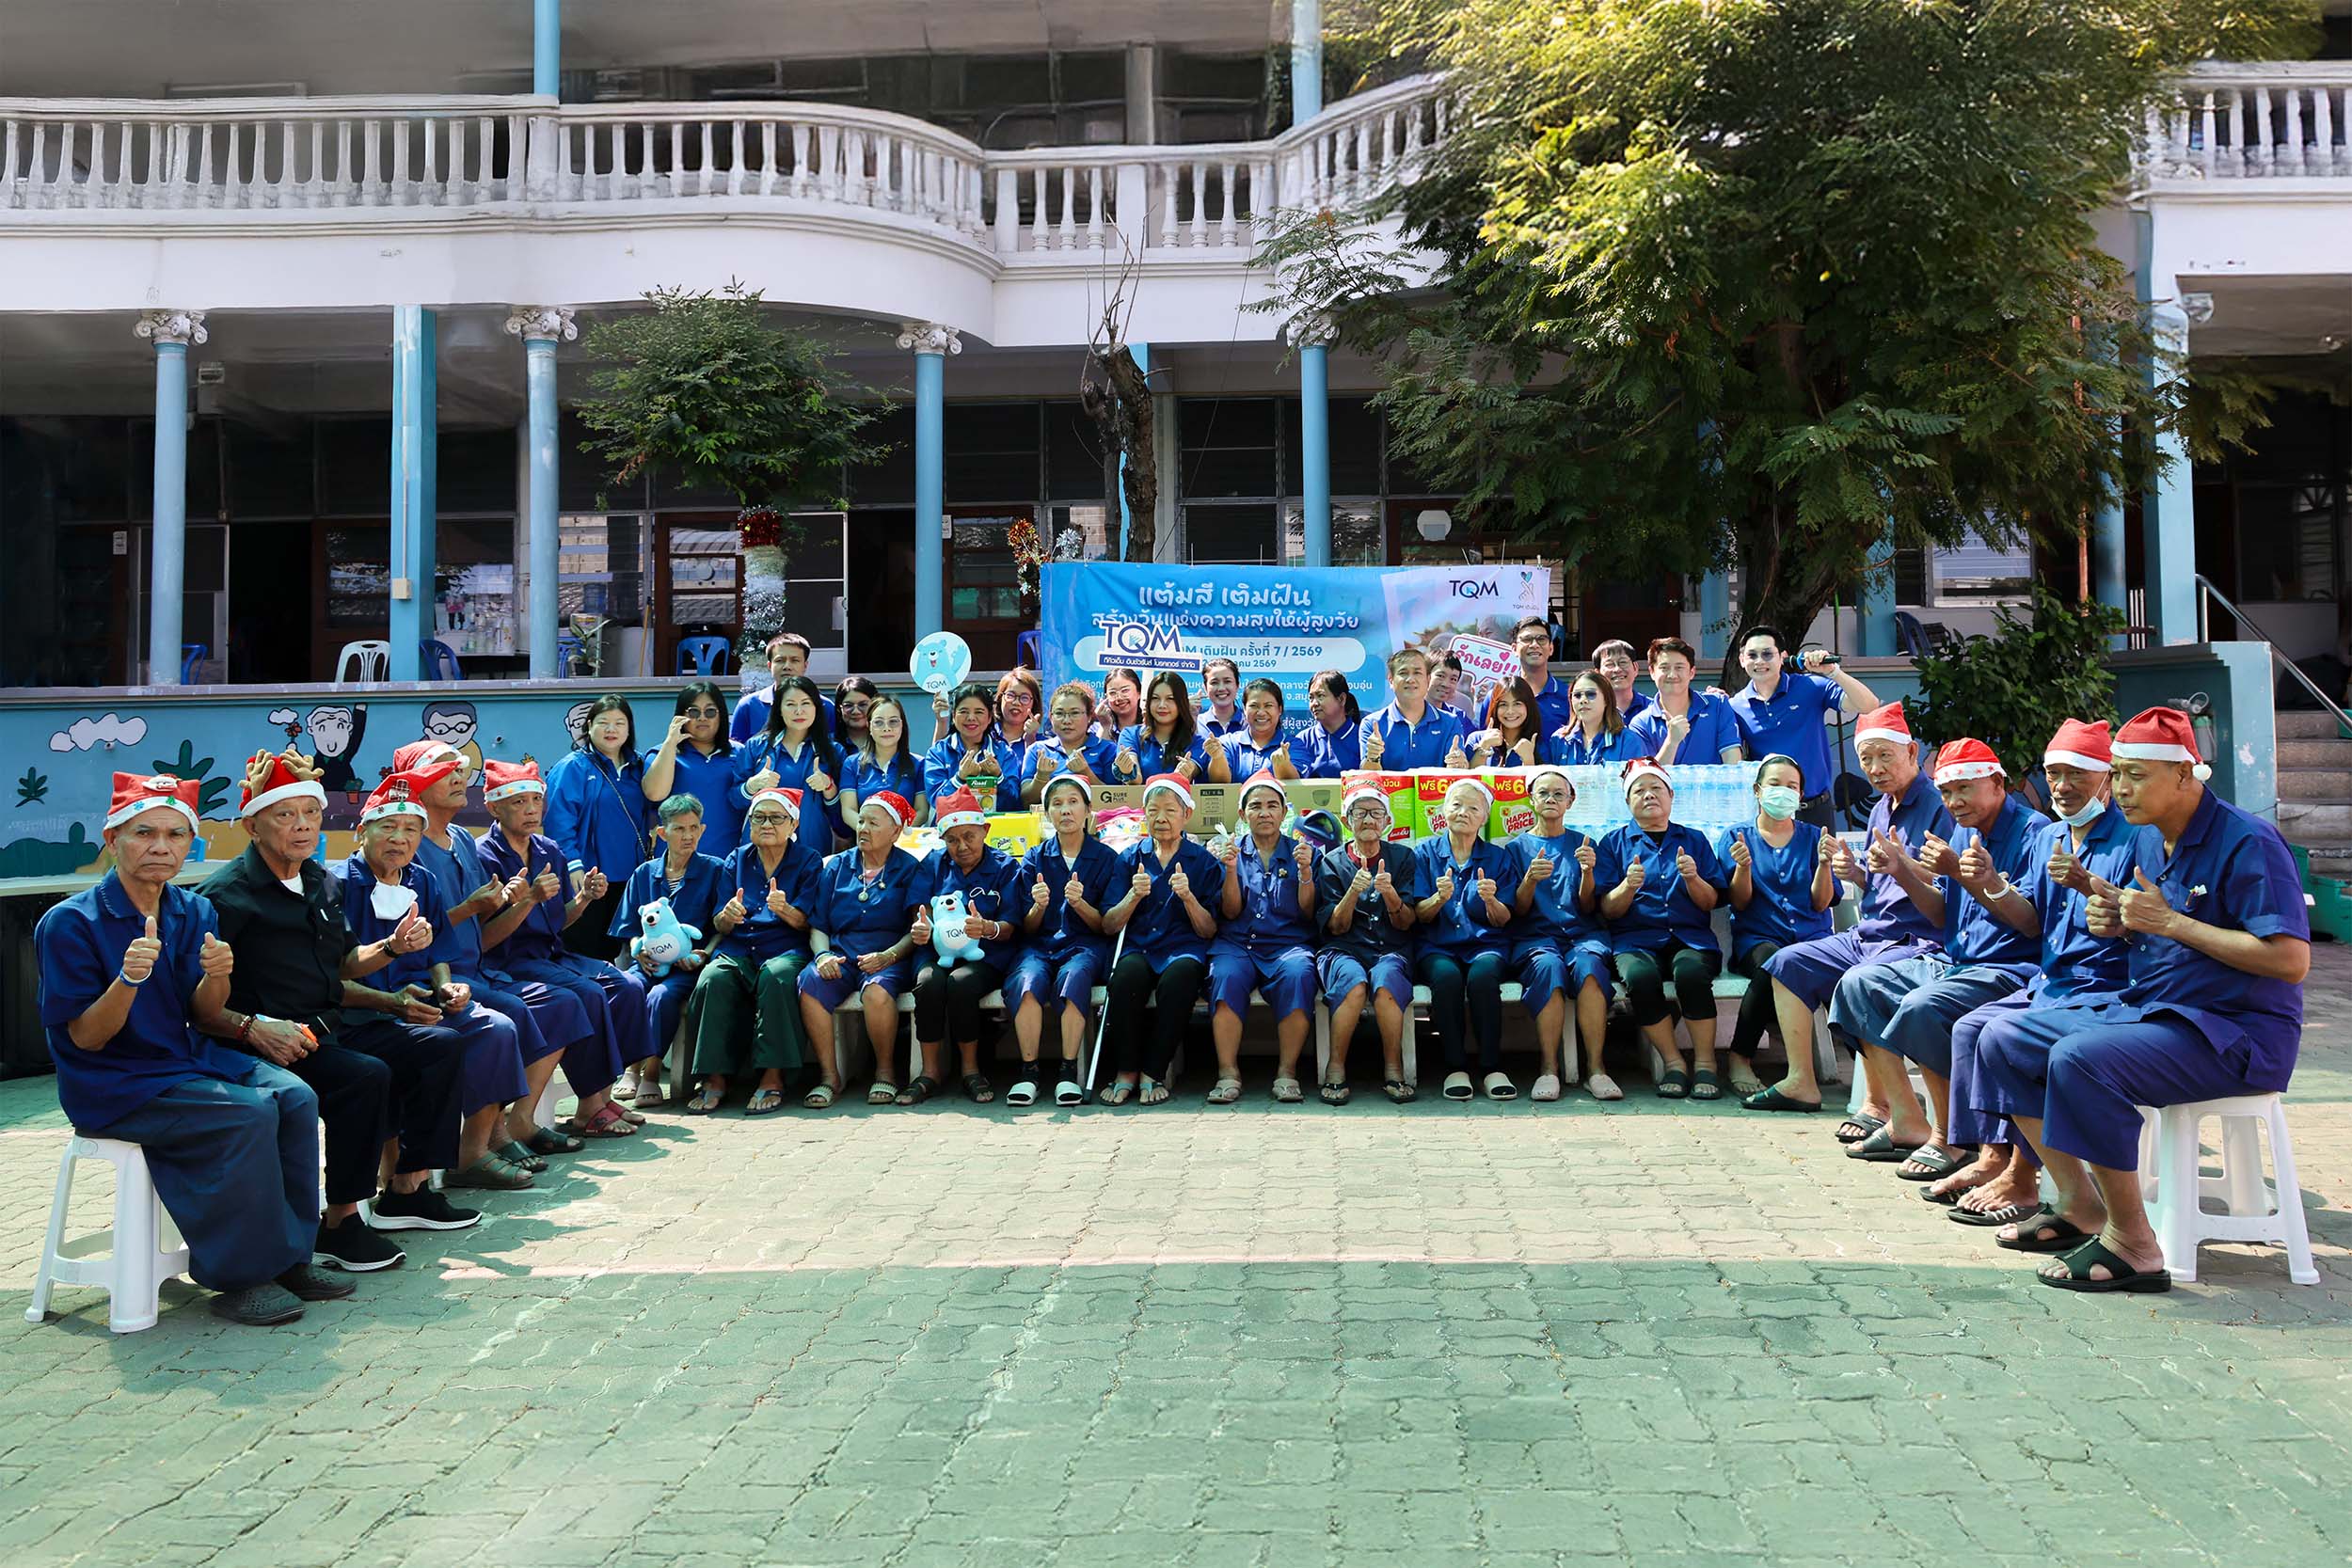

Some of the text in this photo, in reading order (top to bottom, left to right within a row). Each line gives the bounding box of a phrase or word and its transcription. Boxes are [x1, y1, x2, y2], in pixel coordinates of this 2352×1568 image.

[1138, 581, 1311, 607] แต้มสี เติมฝัน
[1449, 580, 1499, 599] TQM
[1102, 623, 1180, 655] TQM
[1240, 641, 1270, 657] ครั้งที่
[1274, 646, 1280, 657] 7
[1292, 646, 1323, 657] 2569
[927, 680, 946, 689] TQM
[1420, 780, 1436, 791] ฟรี
[1437, 779, 1448, 794] 6
[1496, 779, 1524, 795] ฟรี 6
[1506, 811, 1533, 826] HAPPY
[1507, 817, 1534, 833] PRICE
[651, 942, 673, 955] TQM
